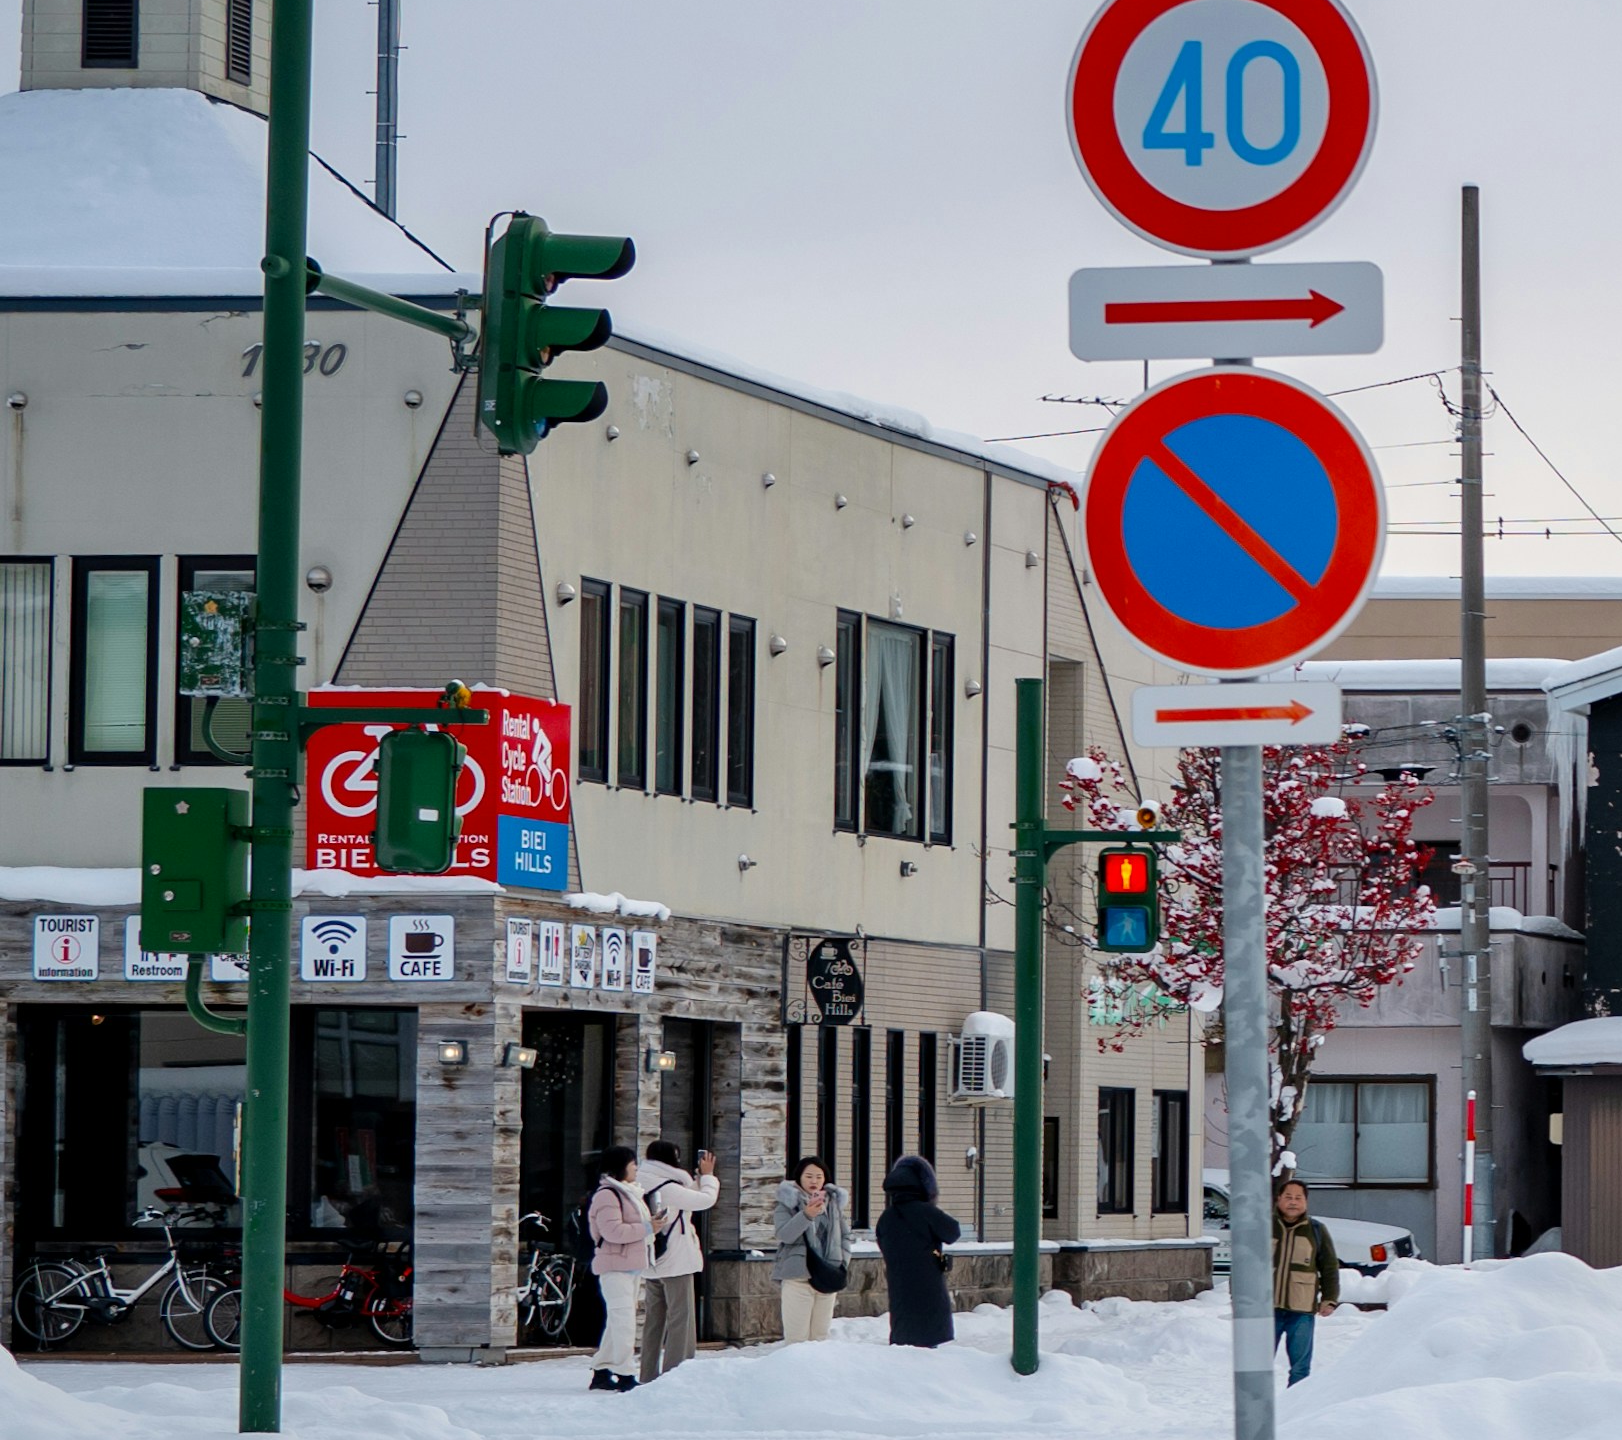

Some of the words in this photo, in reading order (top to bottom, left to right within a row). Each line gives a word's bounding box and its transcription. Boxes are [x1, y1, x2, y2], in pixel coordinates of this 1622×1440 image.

[1142, 40, 1302, 166] 40
[242, 341, 347, 378] 130
[503, 709, 530, 740] Rental
[502, 741, 526, 775] Cycle
[502, 776, 532, 806] Station
[521, 829, 546, 851] BIEI
[316, 848, 379, 868] BIE
[515, 851, 552, 873] HILLS
[39, 918, 95, 932] TOURIST
[38, 967, 94, 977] information
[131, 964, 183, 976] Restroom
[313, 959, 355, 977] Wi-Fi
[400, 961, 442, 976] CAFE
[635, 974, 651, 990] CAFE
[832, 990, 856, 1003] Biei
[825, 1003, 854, 1016] Hills
